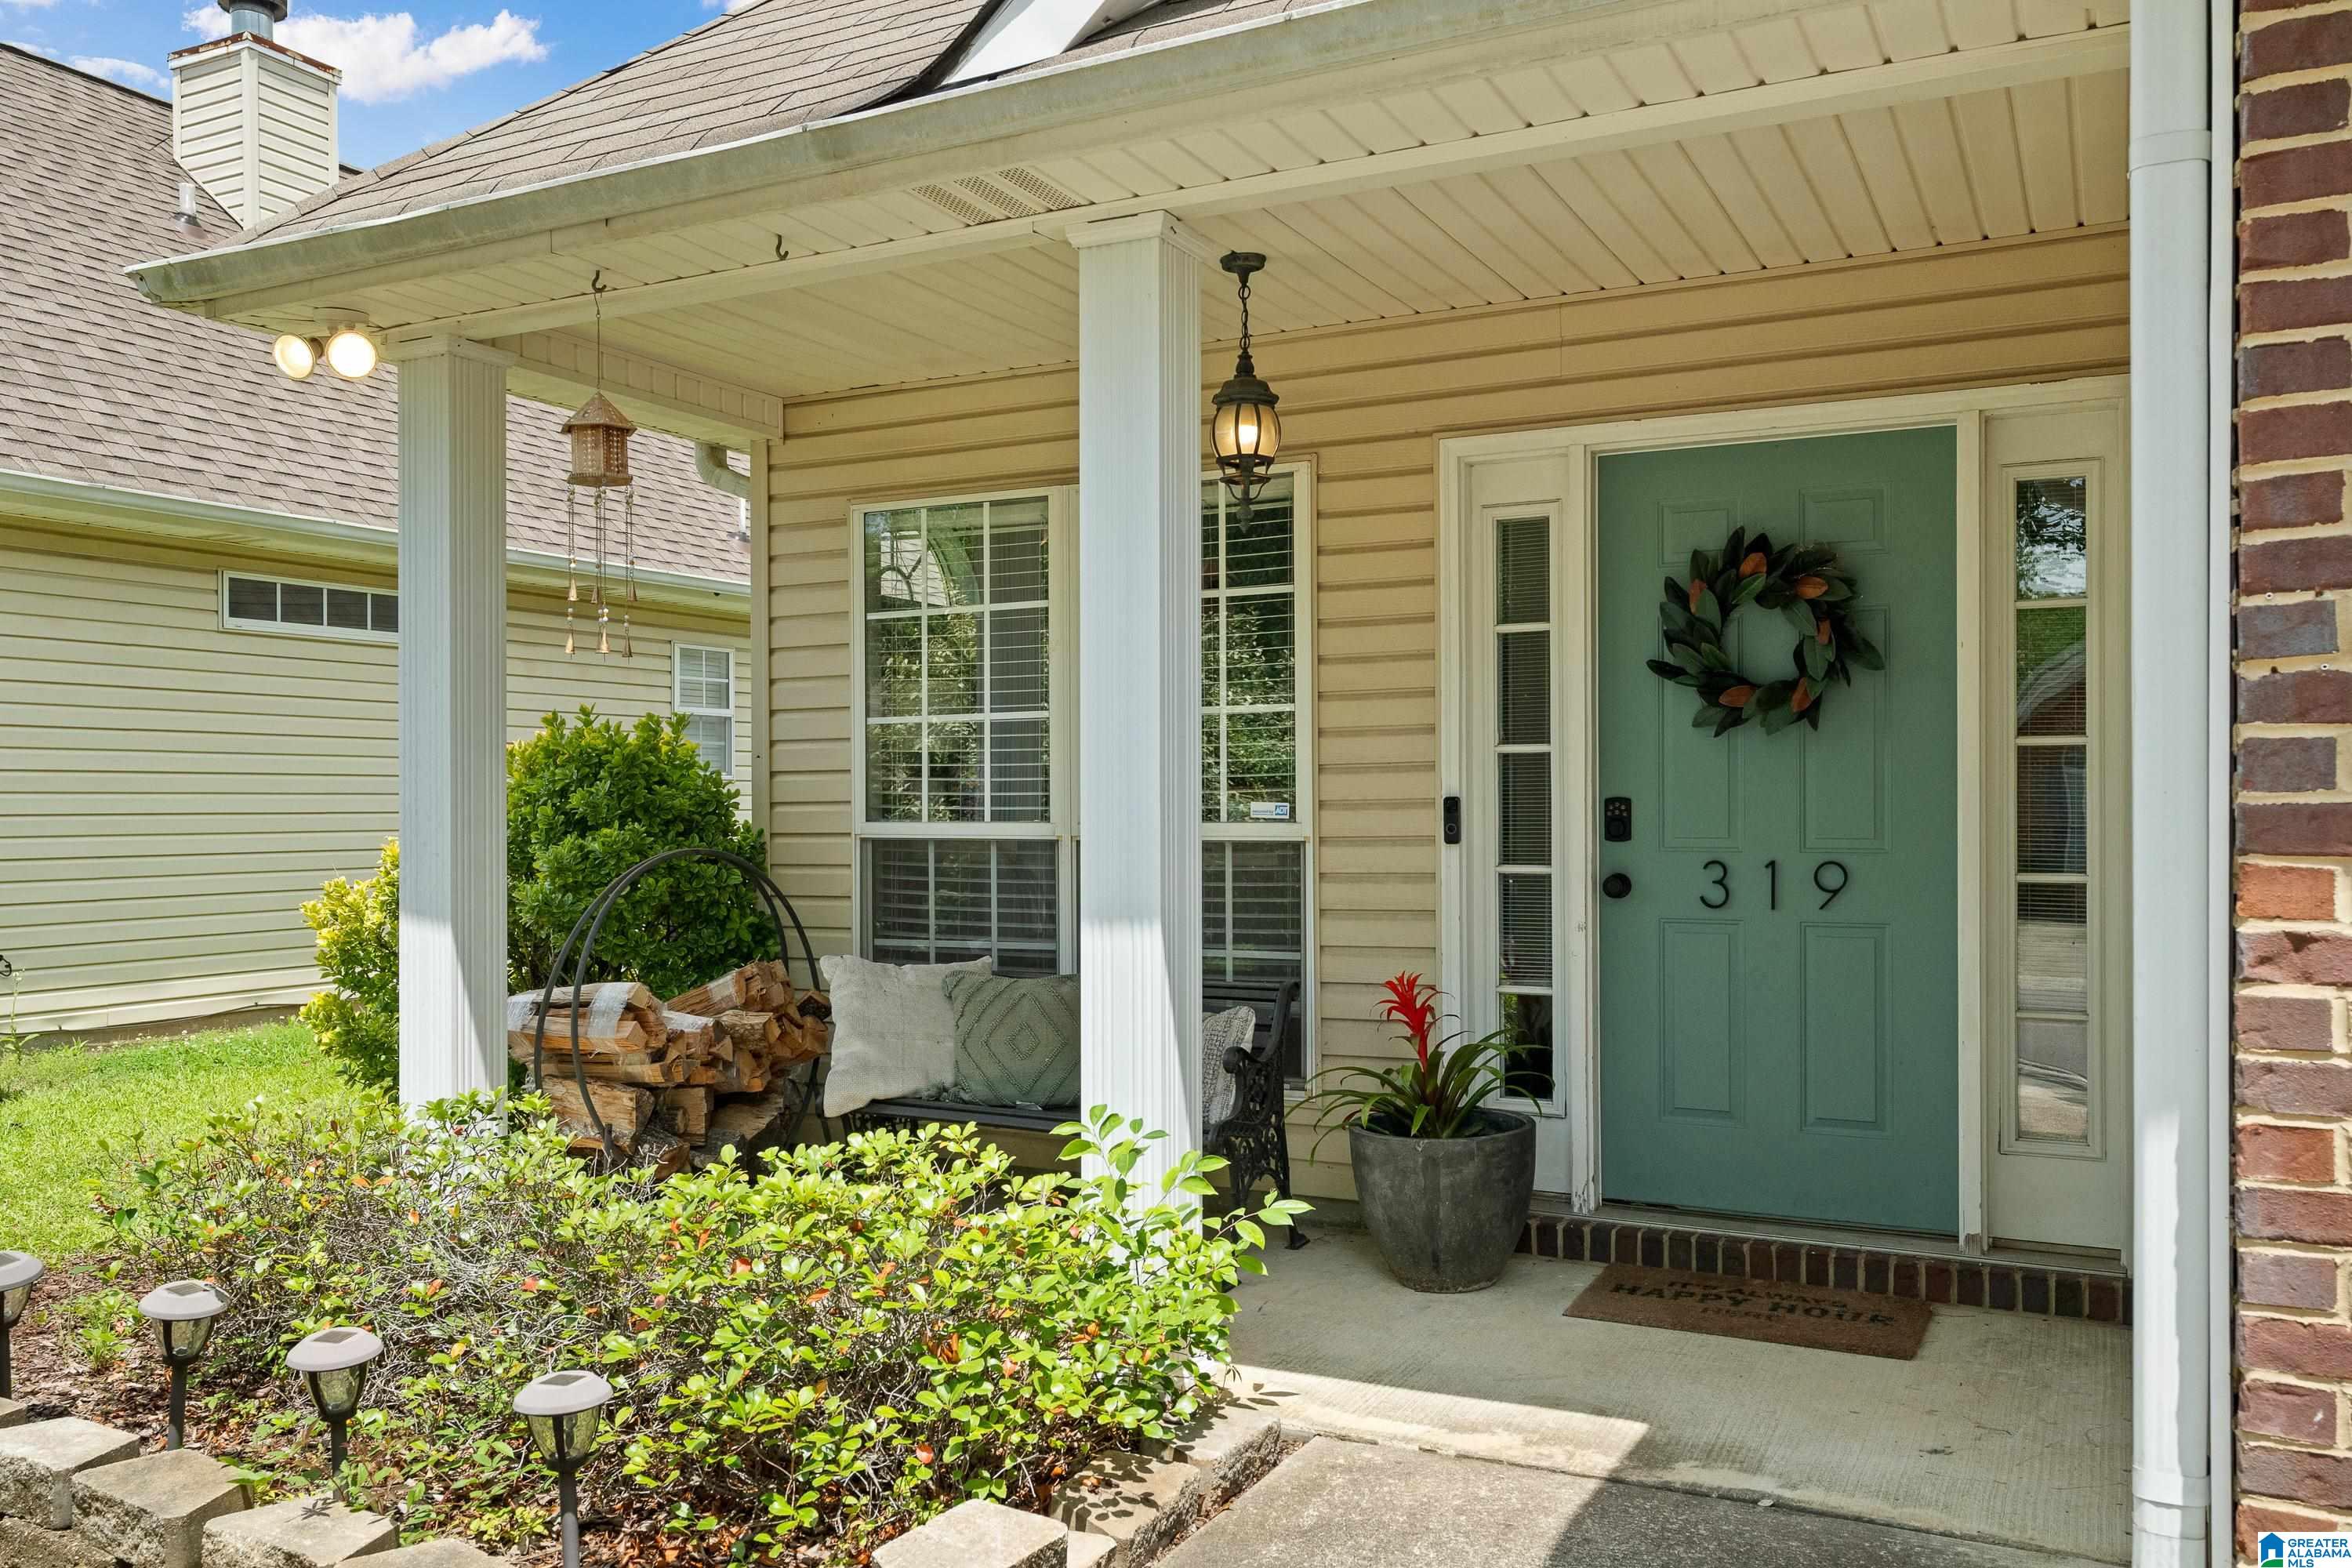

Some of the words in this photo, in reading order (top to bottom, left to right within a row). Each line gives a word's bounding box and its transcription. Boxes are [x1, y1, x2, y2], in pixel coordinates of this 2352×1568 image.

[1275, 805, 1287, 815] ADT
[1699, 860, 1849, 910] 319
[1610, 1283, 1748, 1307] HAPPY
[1768, 1301, 1896, 1326] HOUR
